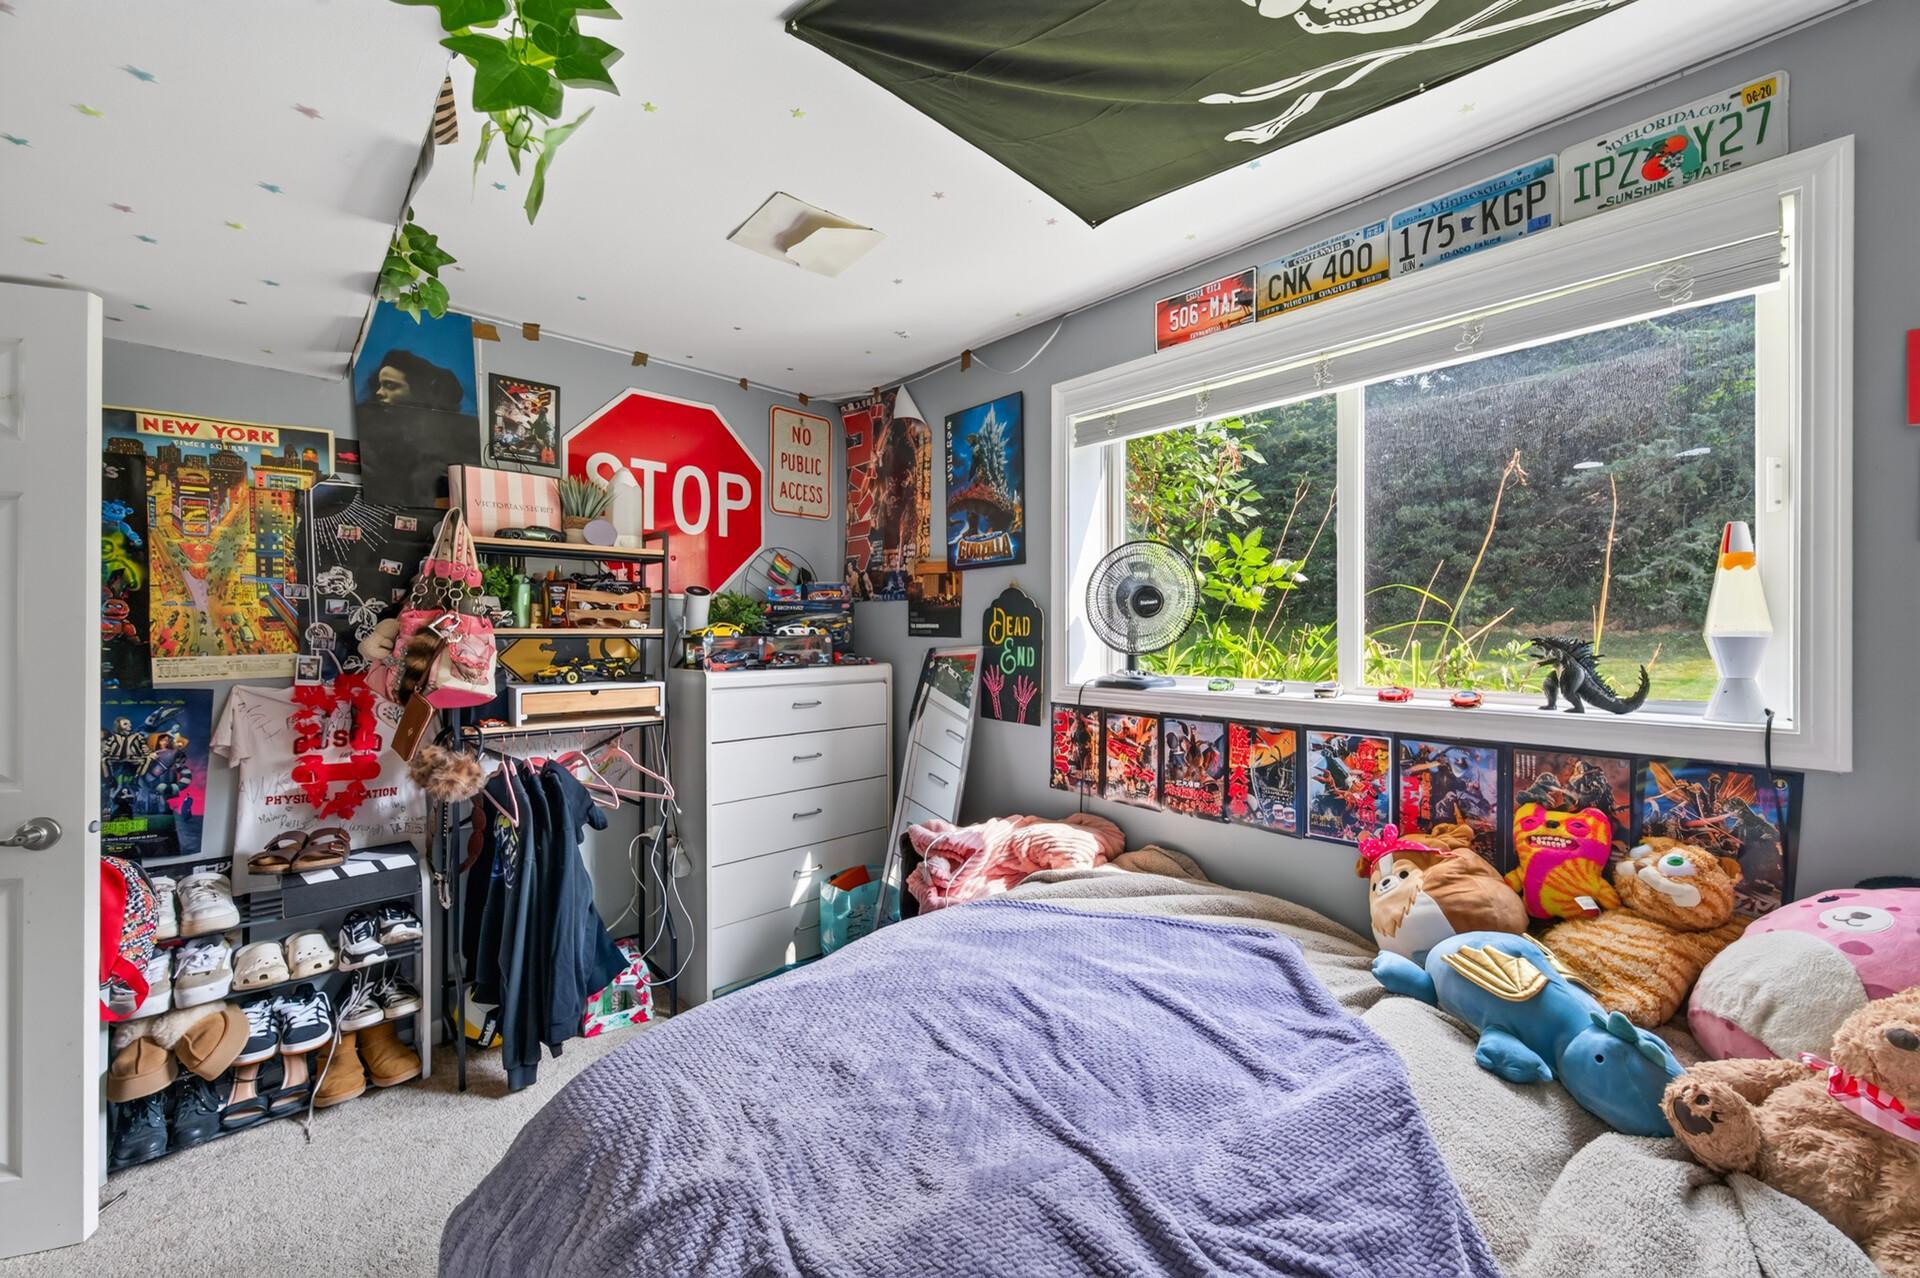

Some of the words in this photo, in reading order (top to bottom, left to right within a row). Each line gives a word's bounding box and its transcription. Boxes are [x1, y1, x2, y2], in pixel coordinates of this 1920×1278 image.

[1605, 102, 1732, 153] MYFLORIDA.COM
[1573, 149, 1640, 204] IPZ
[1693, 100, 1771, 162] Y27
[1606, 176, 1675, 207] SUNSHINE
[1682, 159, 1731, 184] STATE
[1399, 212, 1455, 262] 175
[1481, 180, 1547, 235] KGP
[1268, 262, 1312, 302] CNK
[1322, 242, 1373, 284] 400
[1400, 259, 1417, 274] JUN
[1168, 287, 1243, 332] 506-MAE
[142, 417, 200, 436] NEW
[212, 423, 275, 444] YORK
[792, 425, 812, 447] NO
[780, 451, 823, 476] PUBLIC
[779, 481, 823, 504] ACCESS
